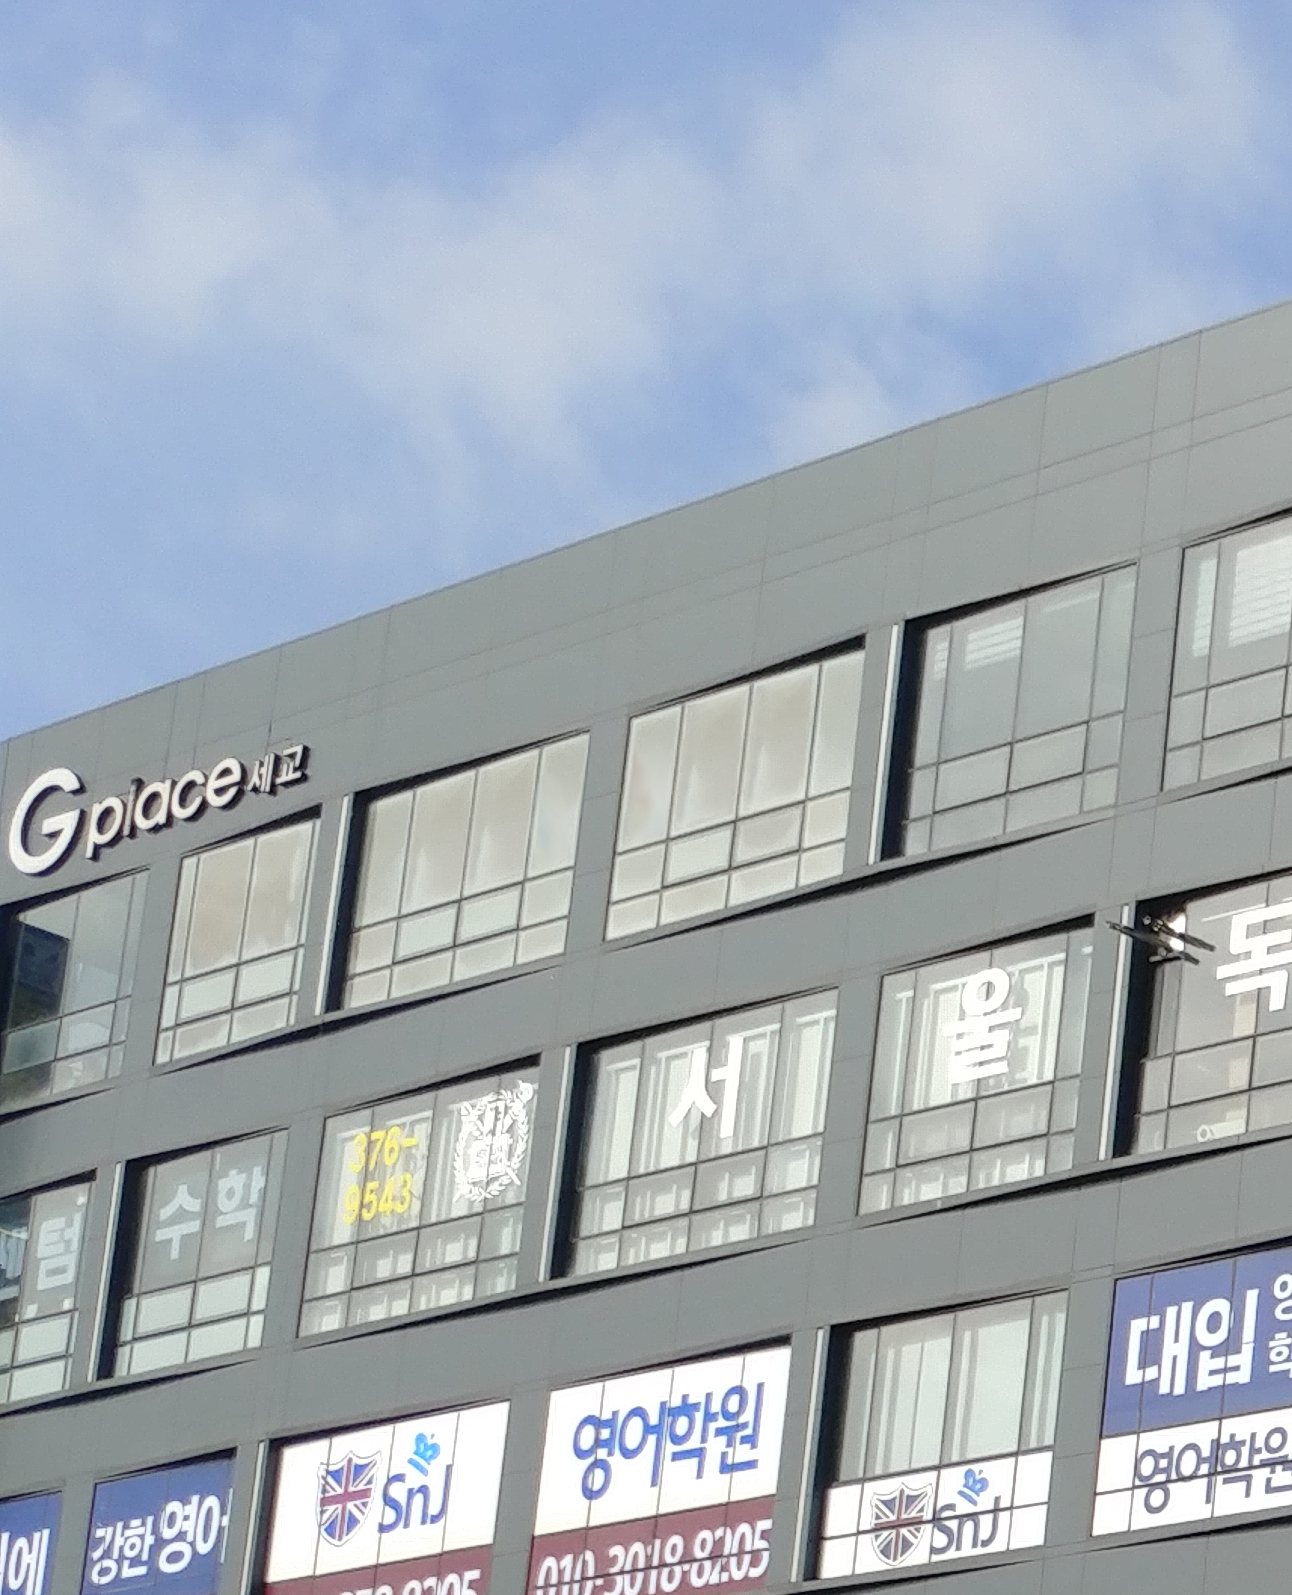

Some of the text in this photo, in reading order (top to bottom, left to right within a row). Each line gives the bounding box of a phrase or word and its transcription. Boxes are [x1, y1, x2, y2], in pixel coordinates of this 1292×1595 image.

[8, 744, 304, 875] Gplace 세교
[154, 1167, 266, 1261] 수학
[1124, 1288, 1260, 1397] 대입
[573, 1381, 765, 1501] 영어학원
